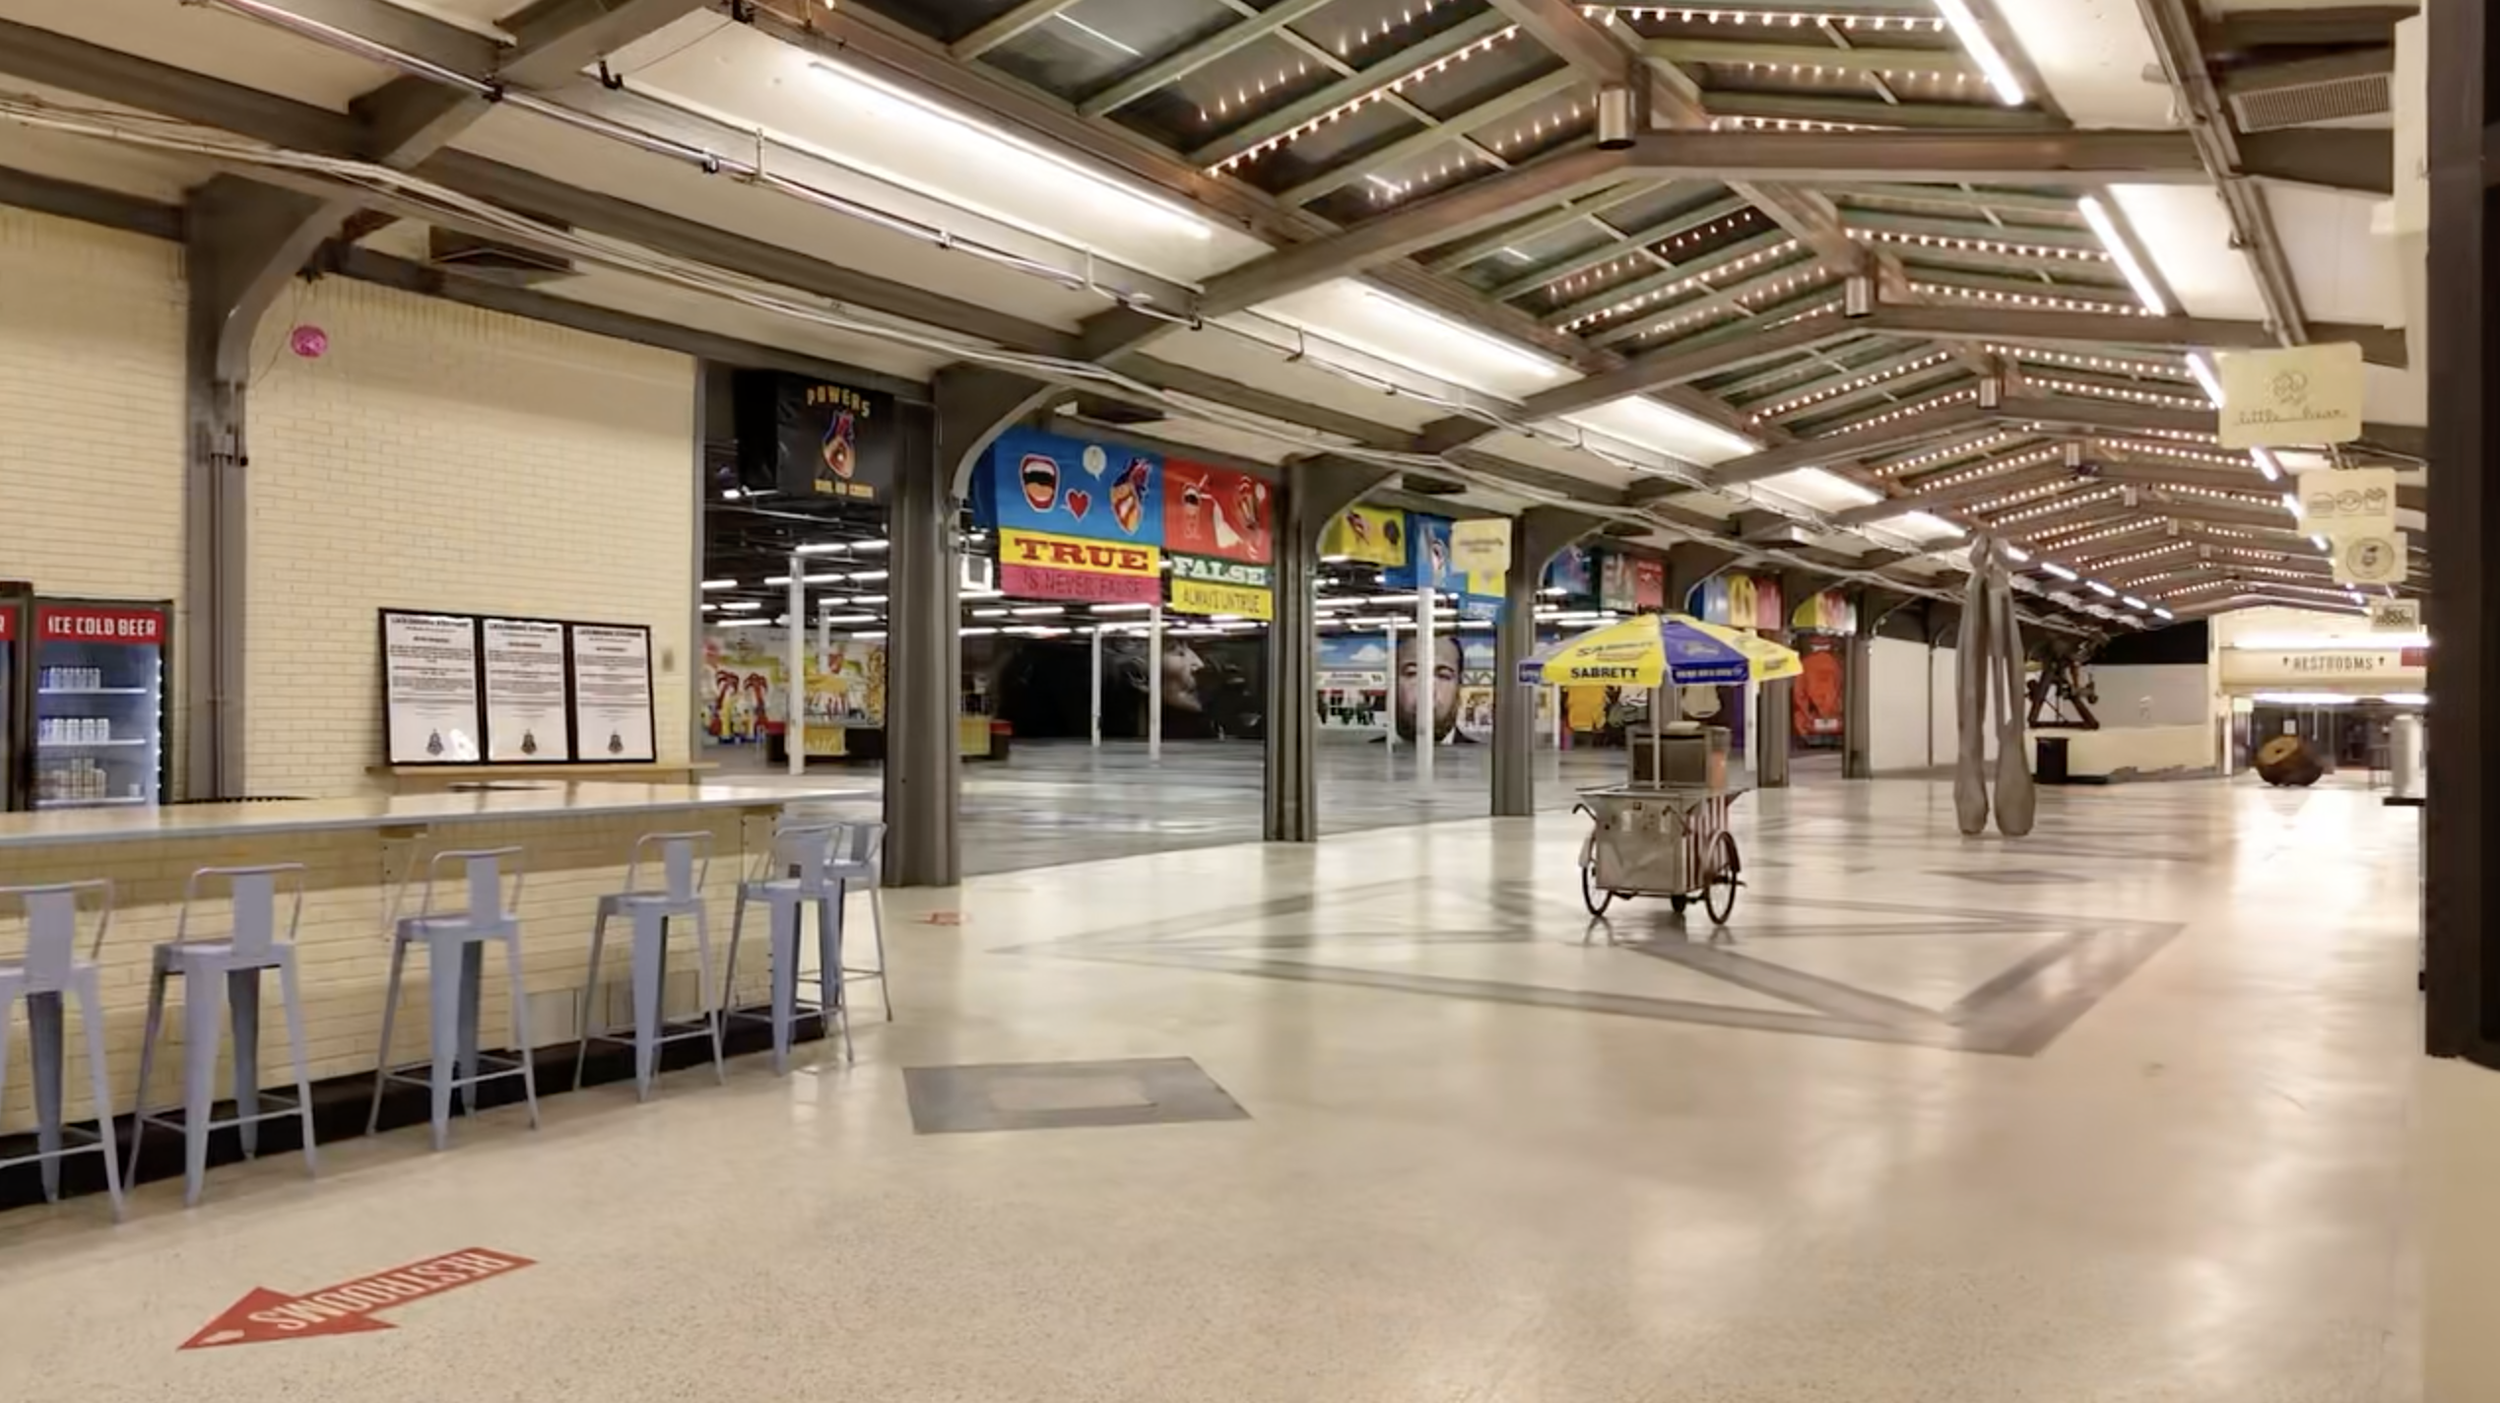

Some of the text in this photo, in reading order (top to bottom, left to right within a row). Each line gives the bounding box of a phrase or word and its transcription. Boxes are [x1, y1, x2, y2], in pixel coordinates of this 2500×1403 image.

[807, 385, 871, 418] POWERS
[1014, 537, 1148, 571] TRUE
[1023, 570, 1142, 597] IS NEVER FALSE
[1173, 556, 1267, 585] FALSE
[1221, 591, 1260, 614] UNTRUE
[48, 615, 156, 637] ICE COLD BEER
[1571, 667, 1639, 680] SABRETT
[2293, 656, 2373, 671] RESTROOMS
[248, 1252, 516, 1331] RESTROOMS
